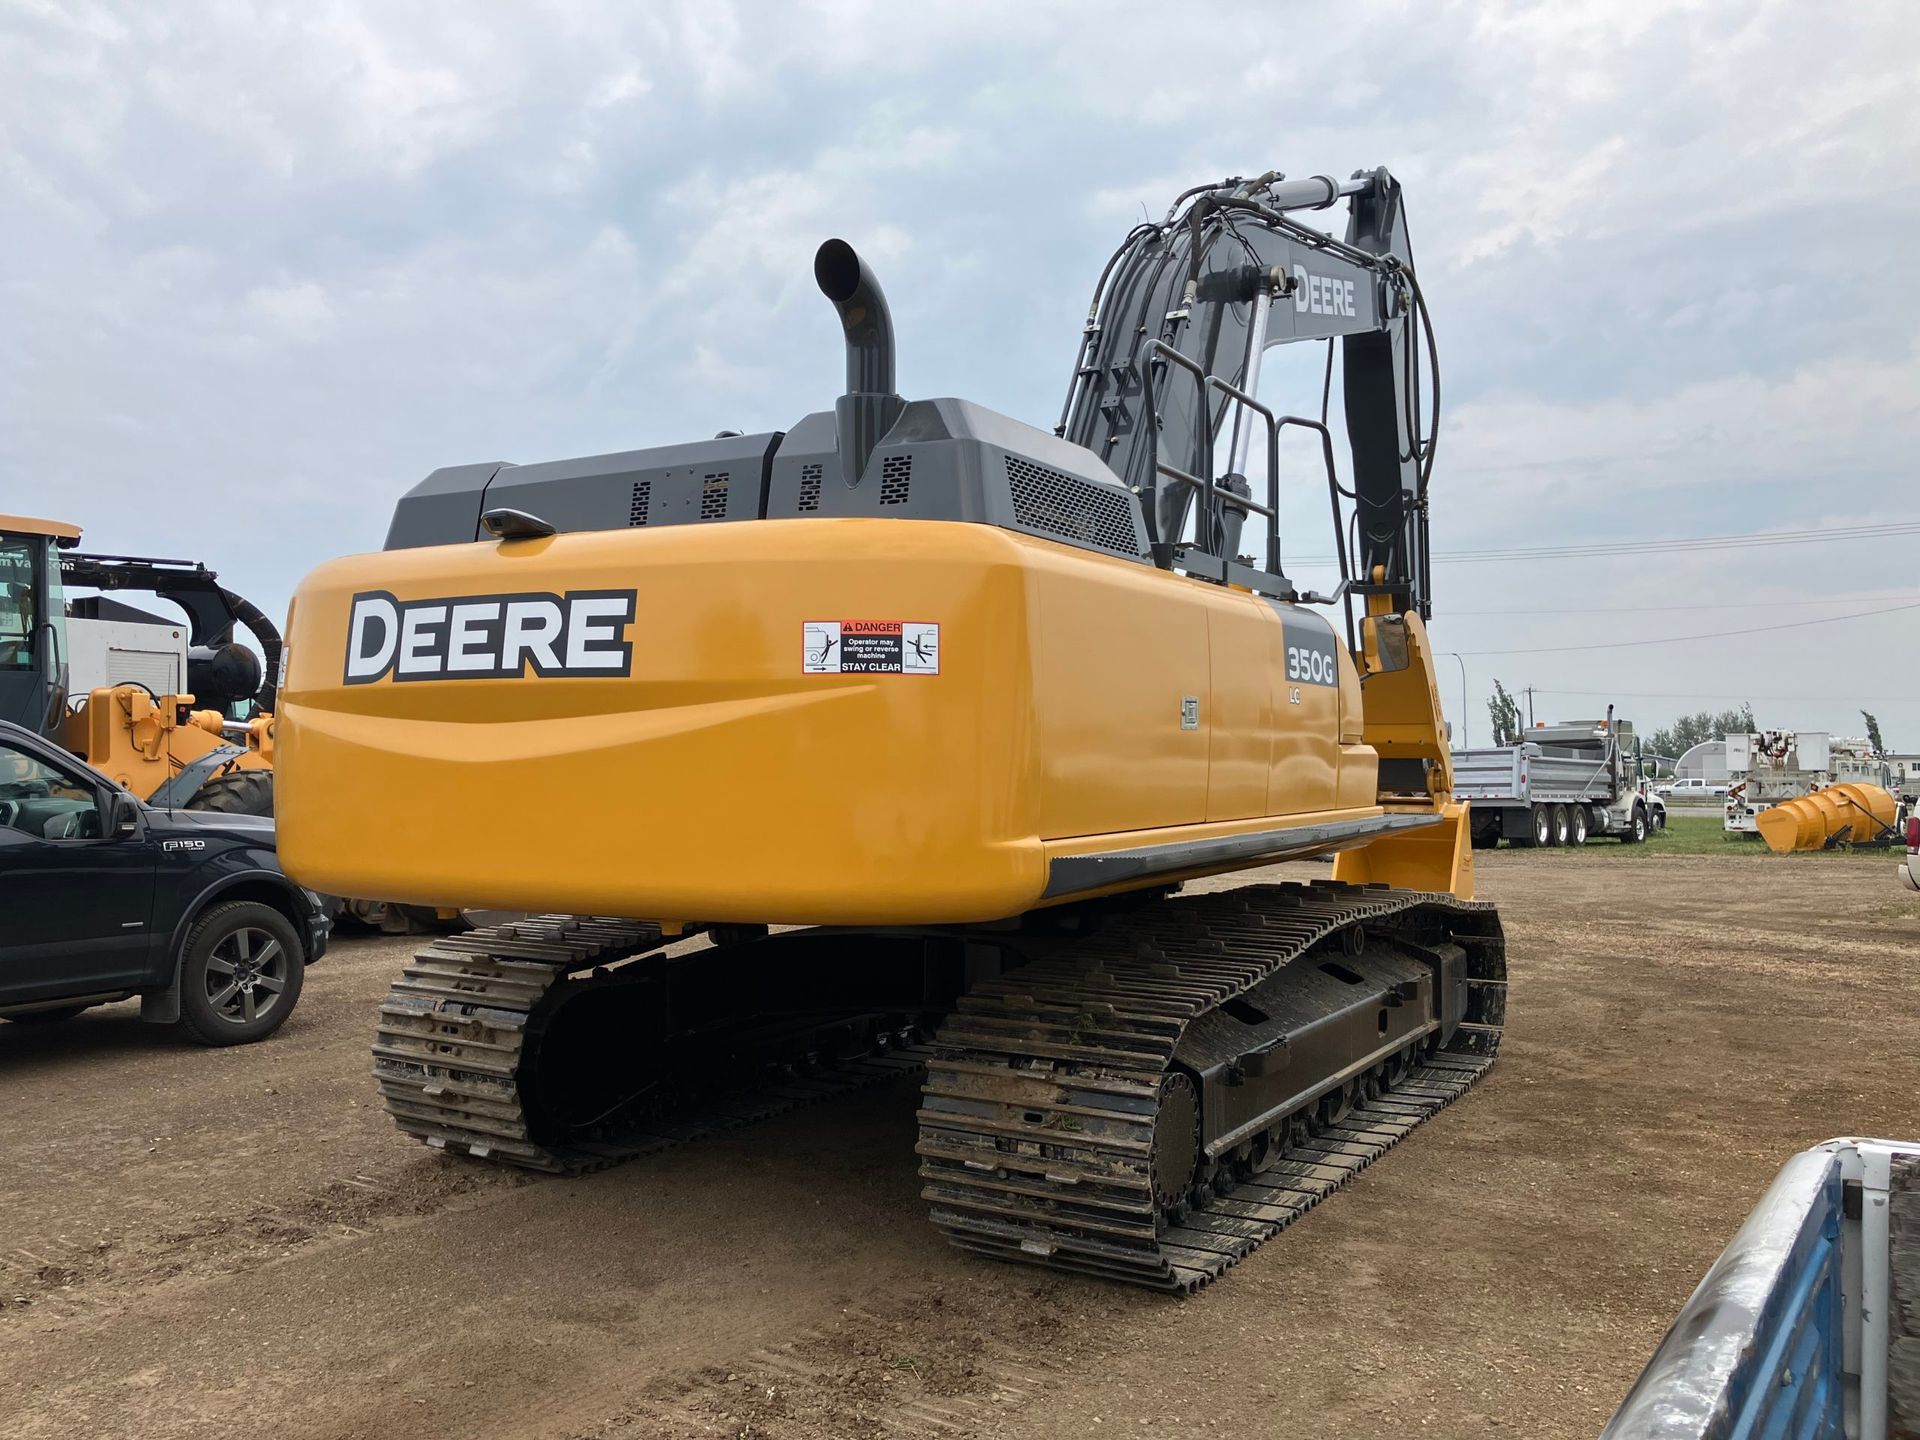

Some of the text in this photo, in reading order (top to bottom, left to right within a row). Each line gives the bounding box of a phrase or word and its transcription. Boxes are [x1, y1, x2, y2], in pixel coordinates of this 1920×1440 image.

[1293, 264, 1356, 317] DEERE
[855, 623, 901, 632] DANGER
[348, 598, 629, 677] DEERE
[848, 638, 879, 646] Operator
[841, 663, 901, 672] STAY CLEAR
[1288, 646, 1333, 684] 350G
[1289, 687, 1300, 704] LC
